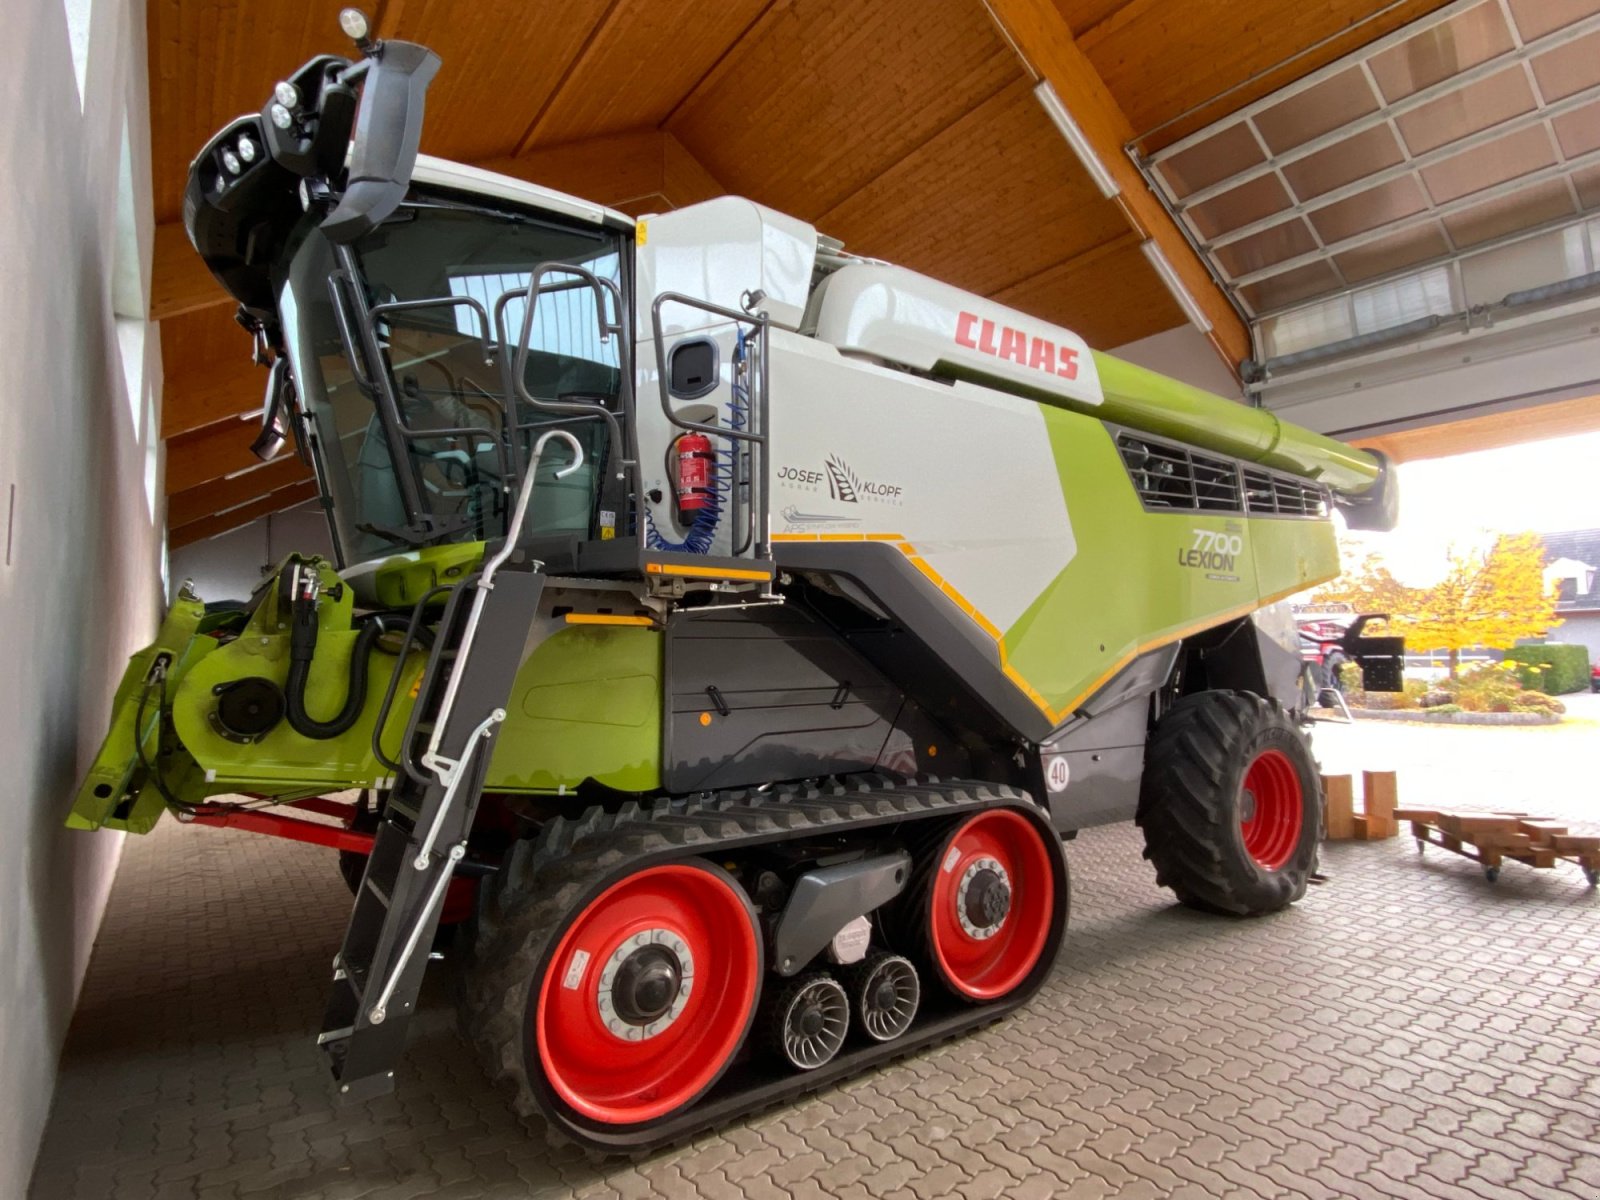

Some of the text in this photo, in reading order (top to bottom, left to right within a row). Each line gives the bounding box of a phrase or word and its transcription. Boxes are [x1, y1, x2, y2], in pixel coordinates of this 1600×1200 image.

[954, 310, 1079, 381] CLAAS
[777, 466, 902, 498] JOSEF KLOPF
[1192, 528, 1242, 556] 7700
[1178, 547, 1234, 572] LEXION
[1051, 762, 1066, 785] 40
